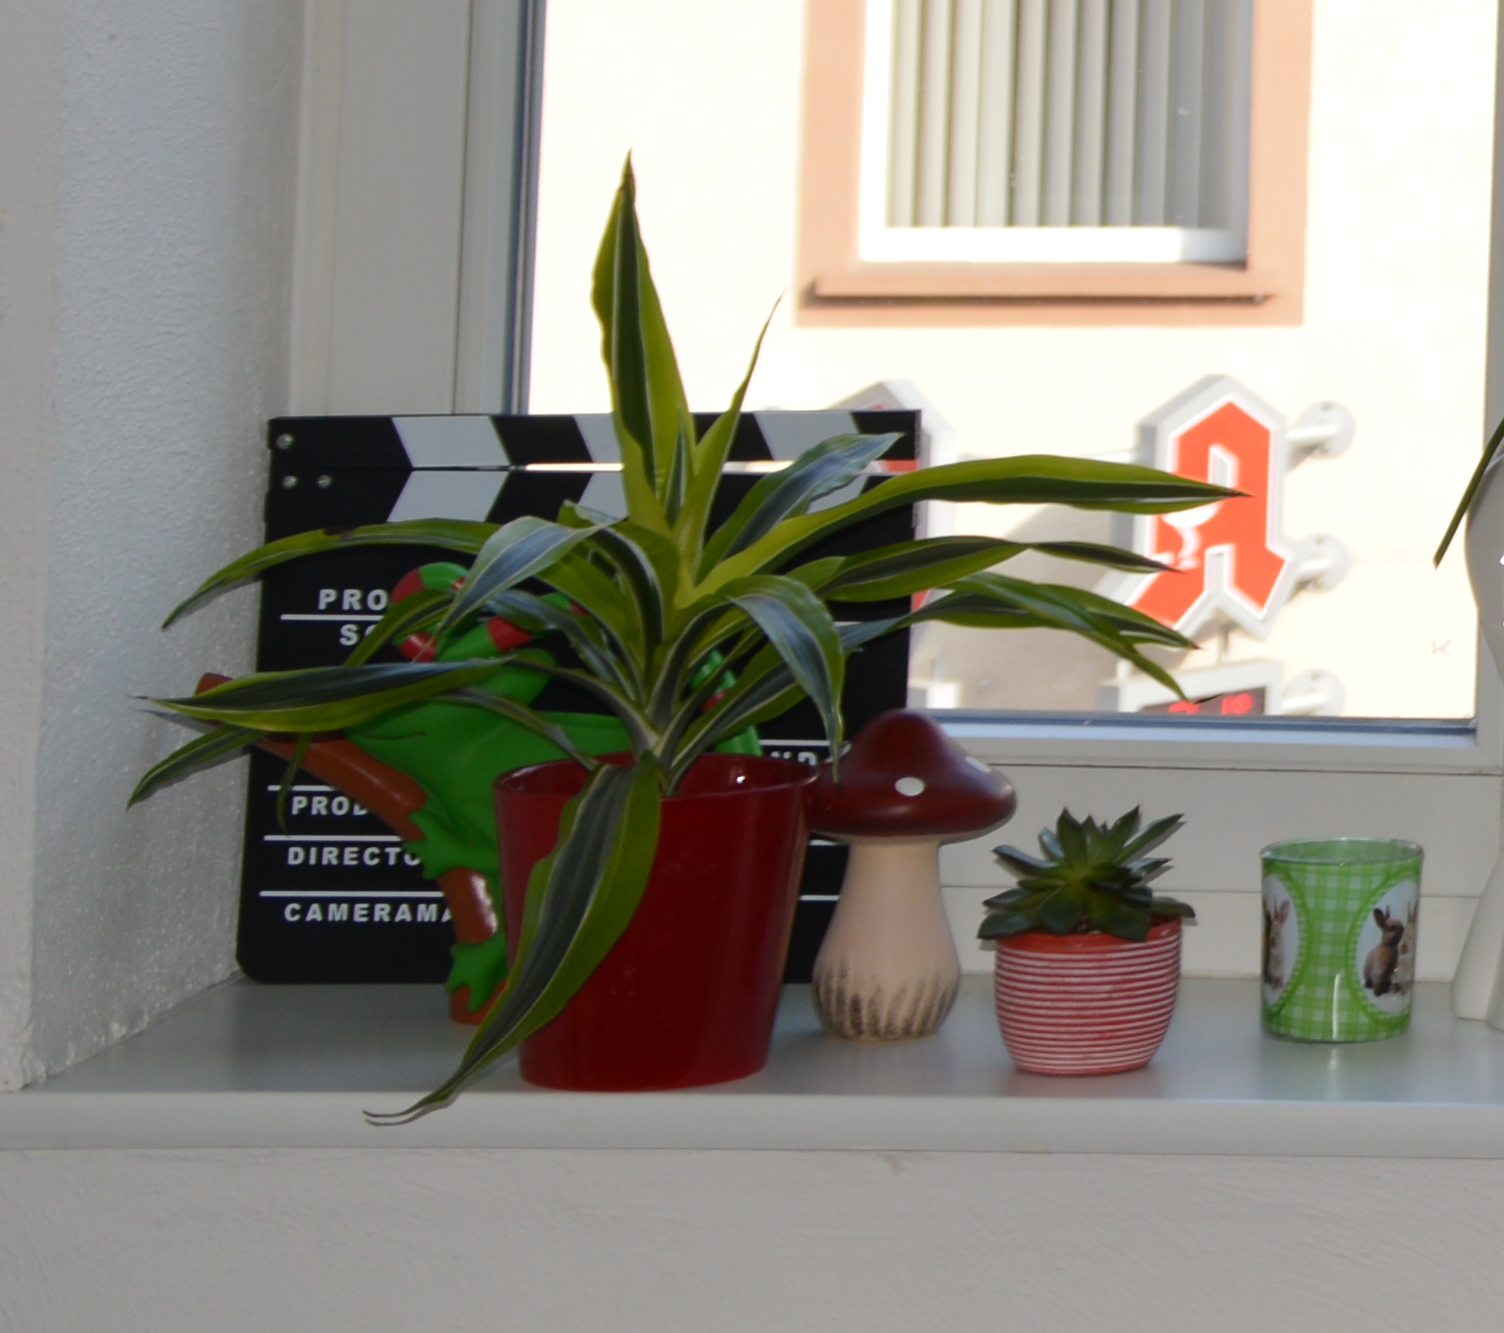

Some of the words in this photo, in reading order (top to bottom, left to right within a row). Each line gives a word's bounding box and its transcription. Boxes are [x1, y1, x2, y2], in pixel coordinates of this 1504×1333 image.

[318, 588, 388, 611] PRO
[287, 846, 422, 866] DIRECTO
[284, 903, 453, 923] CAMERAM
